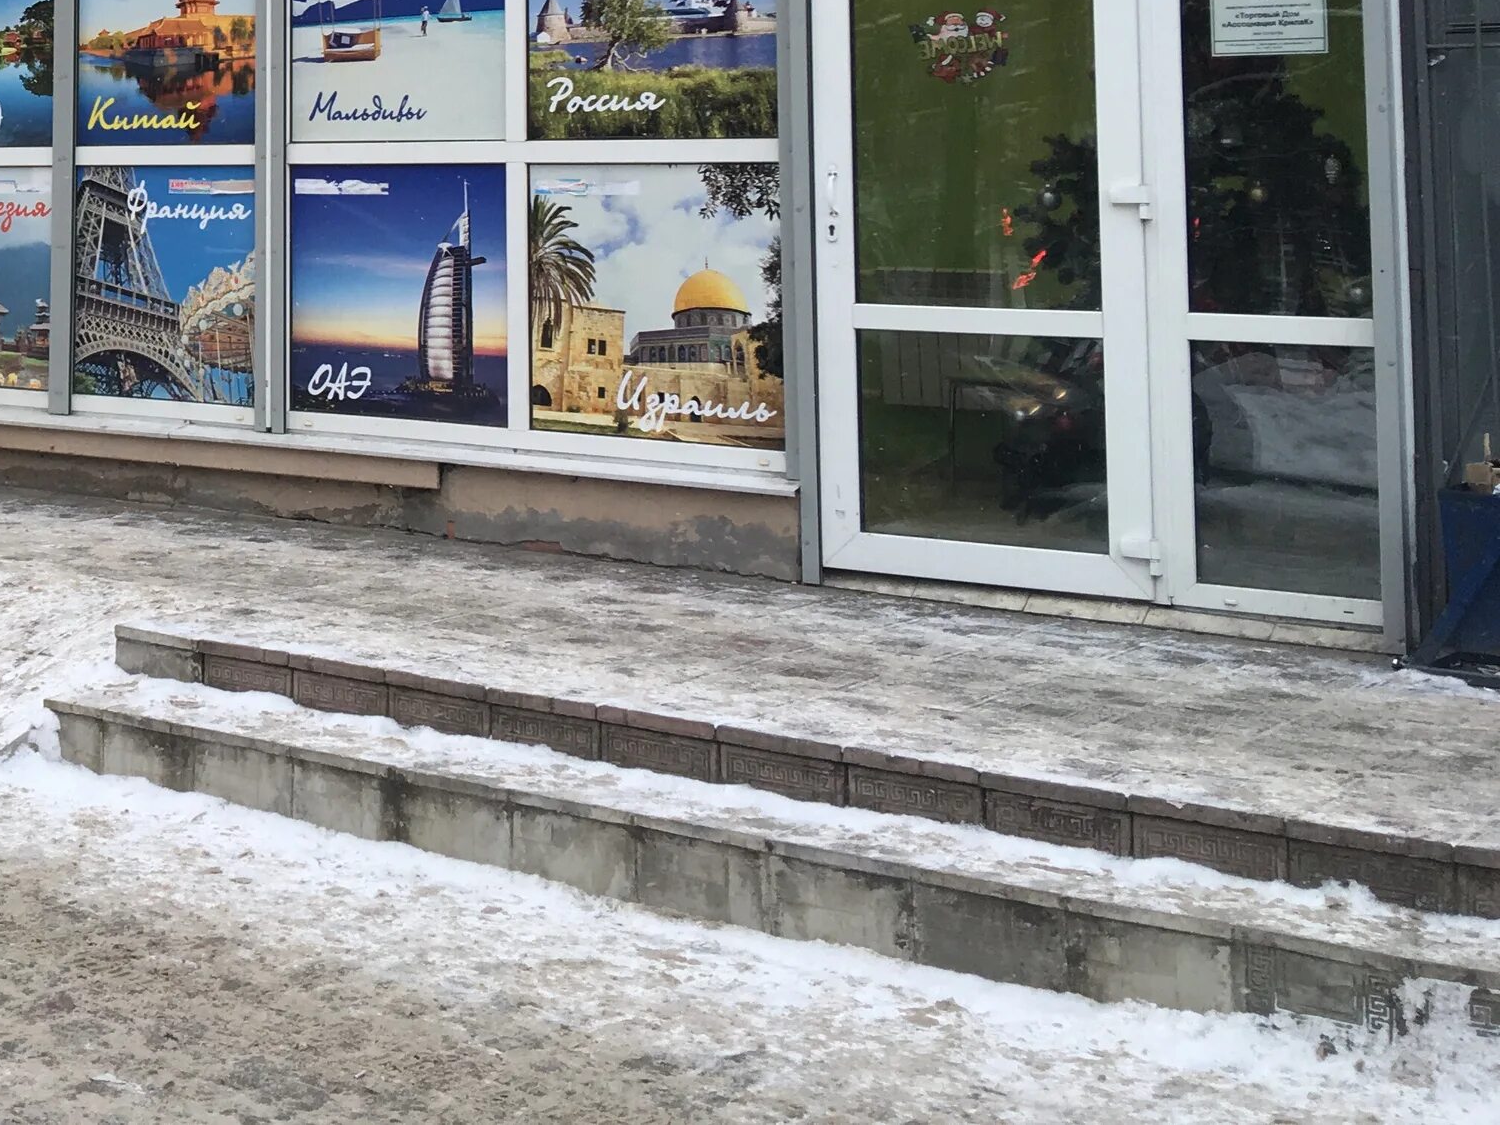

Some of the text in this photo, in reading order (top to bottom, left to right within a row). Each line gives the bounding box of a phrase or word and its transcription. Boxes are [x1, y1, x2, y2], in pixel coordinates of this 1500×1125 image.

[88, 95, 202, 132] Китай
[308, 91, 427, 124] Мальдивы
[546, 76, 666, 114] Россия
[126, 179, 252, 234] Франция
[308, 362, 372, 401] ОАЭ
[616, 369, 777, 433] Израиль
